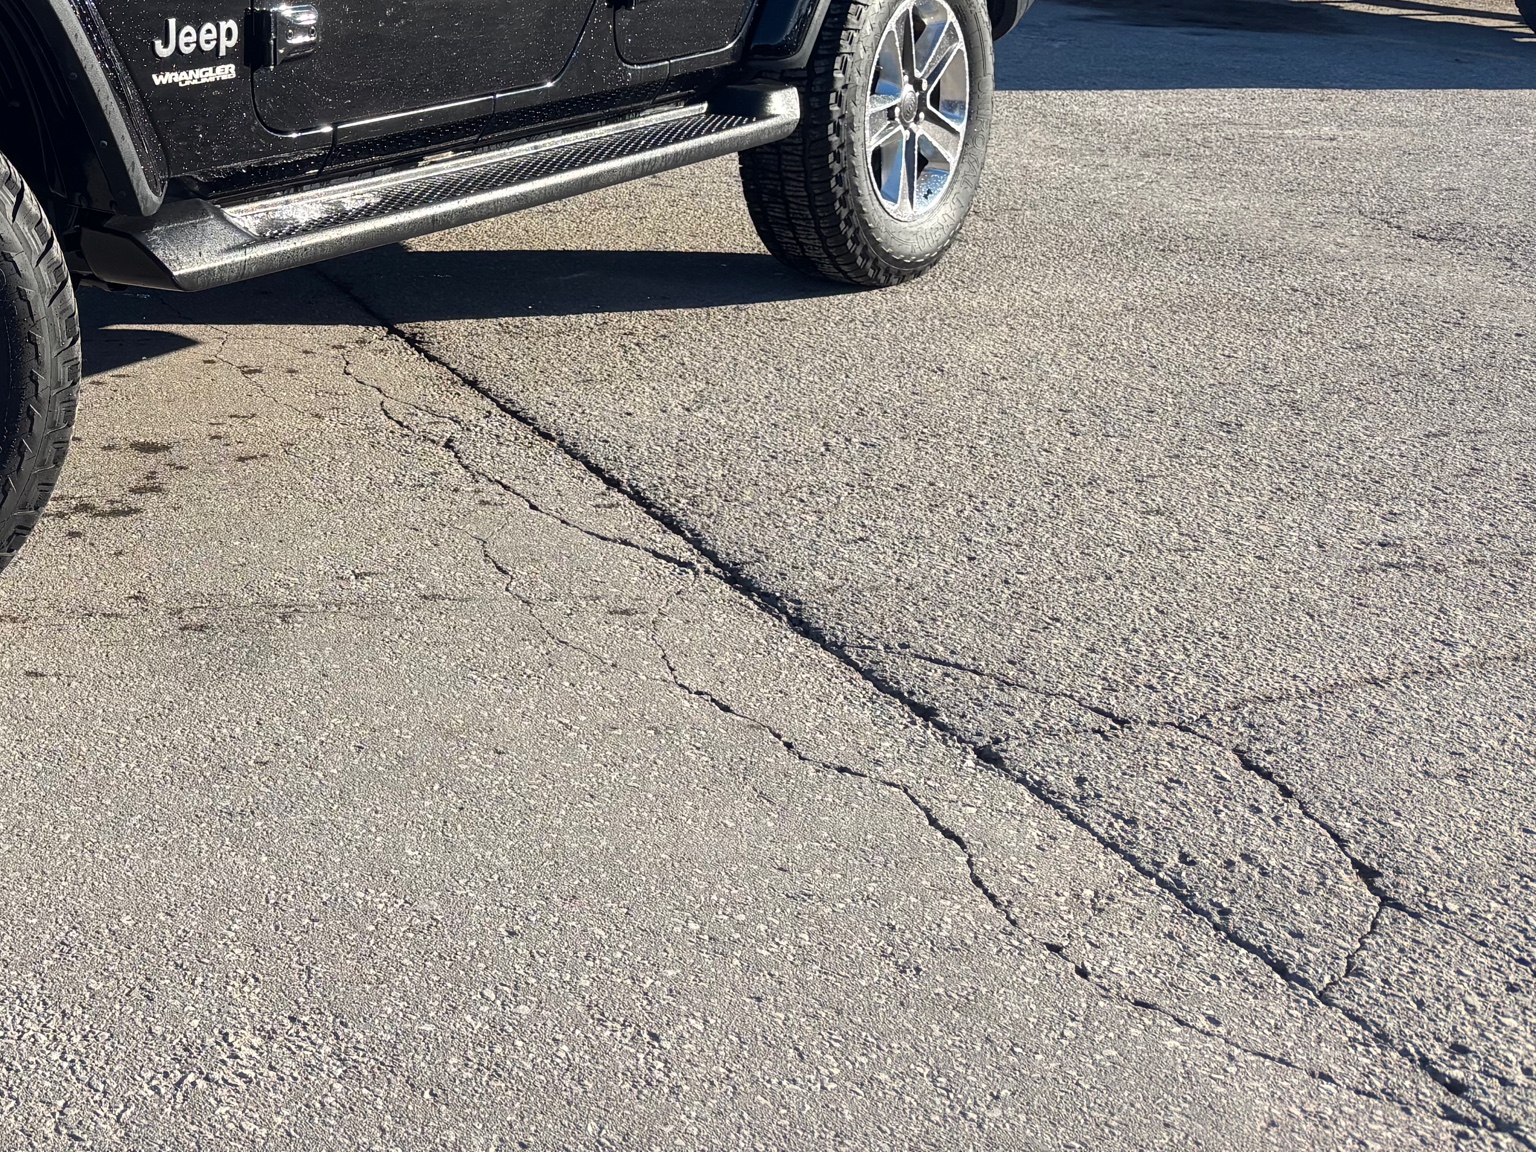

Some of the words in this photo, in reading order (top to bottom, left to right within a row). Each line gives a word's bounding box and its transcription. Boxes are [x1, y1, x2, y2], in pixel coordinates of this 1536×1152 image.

[153, 17, 239, 58] Jeep
[151, 63, 236, 86] WRANGLER
[178, 72, 236, 87] UNLIMITED
